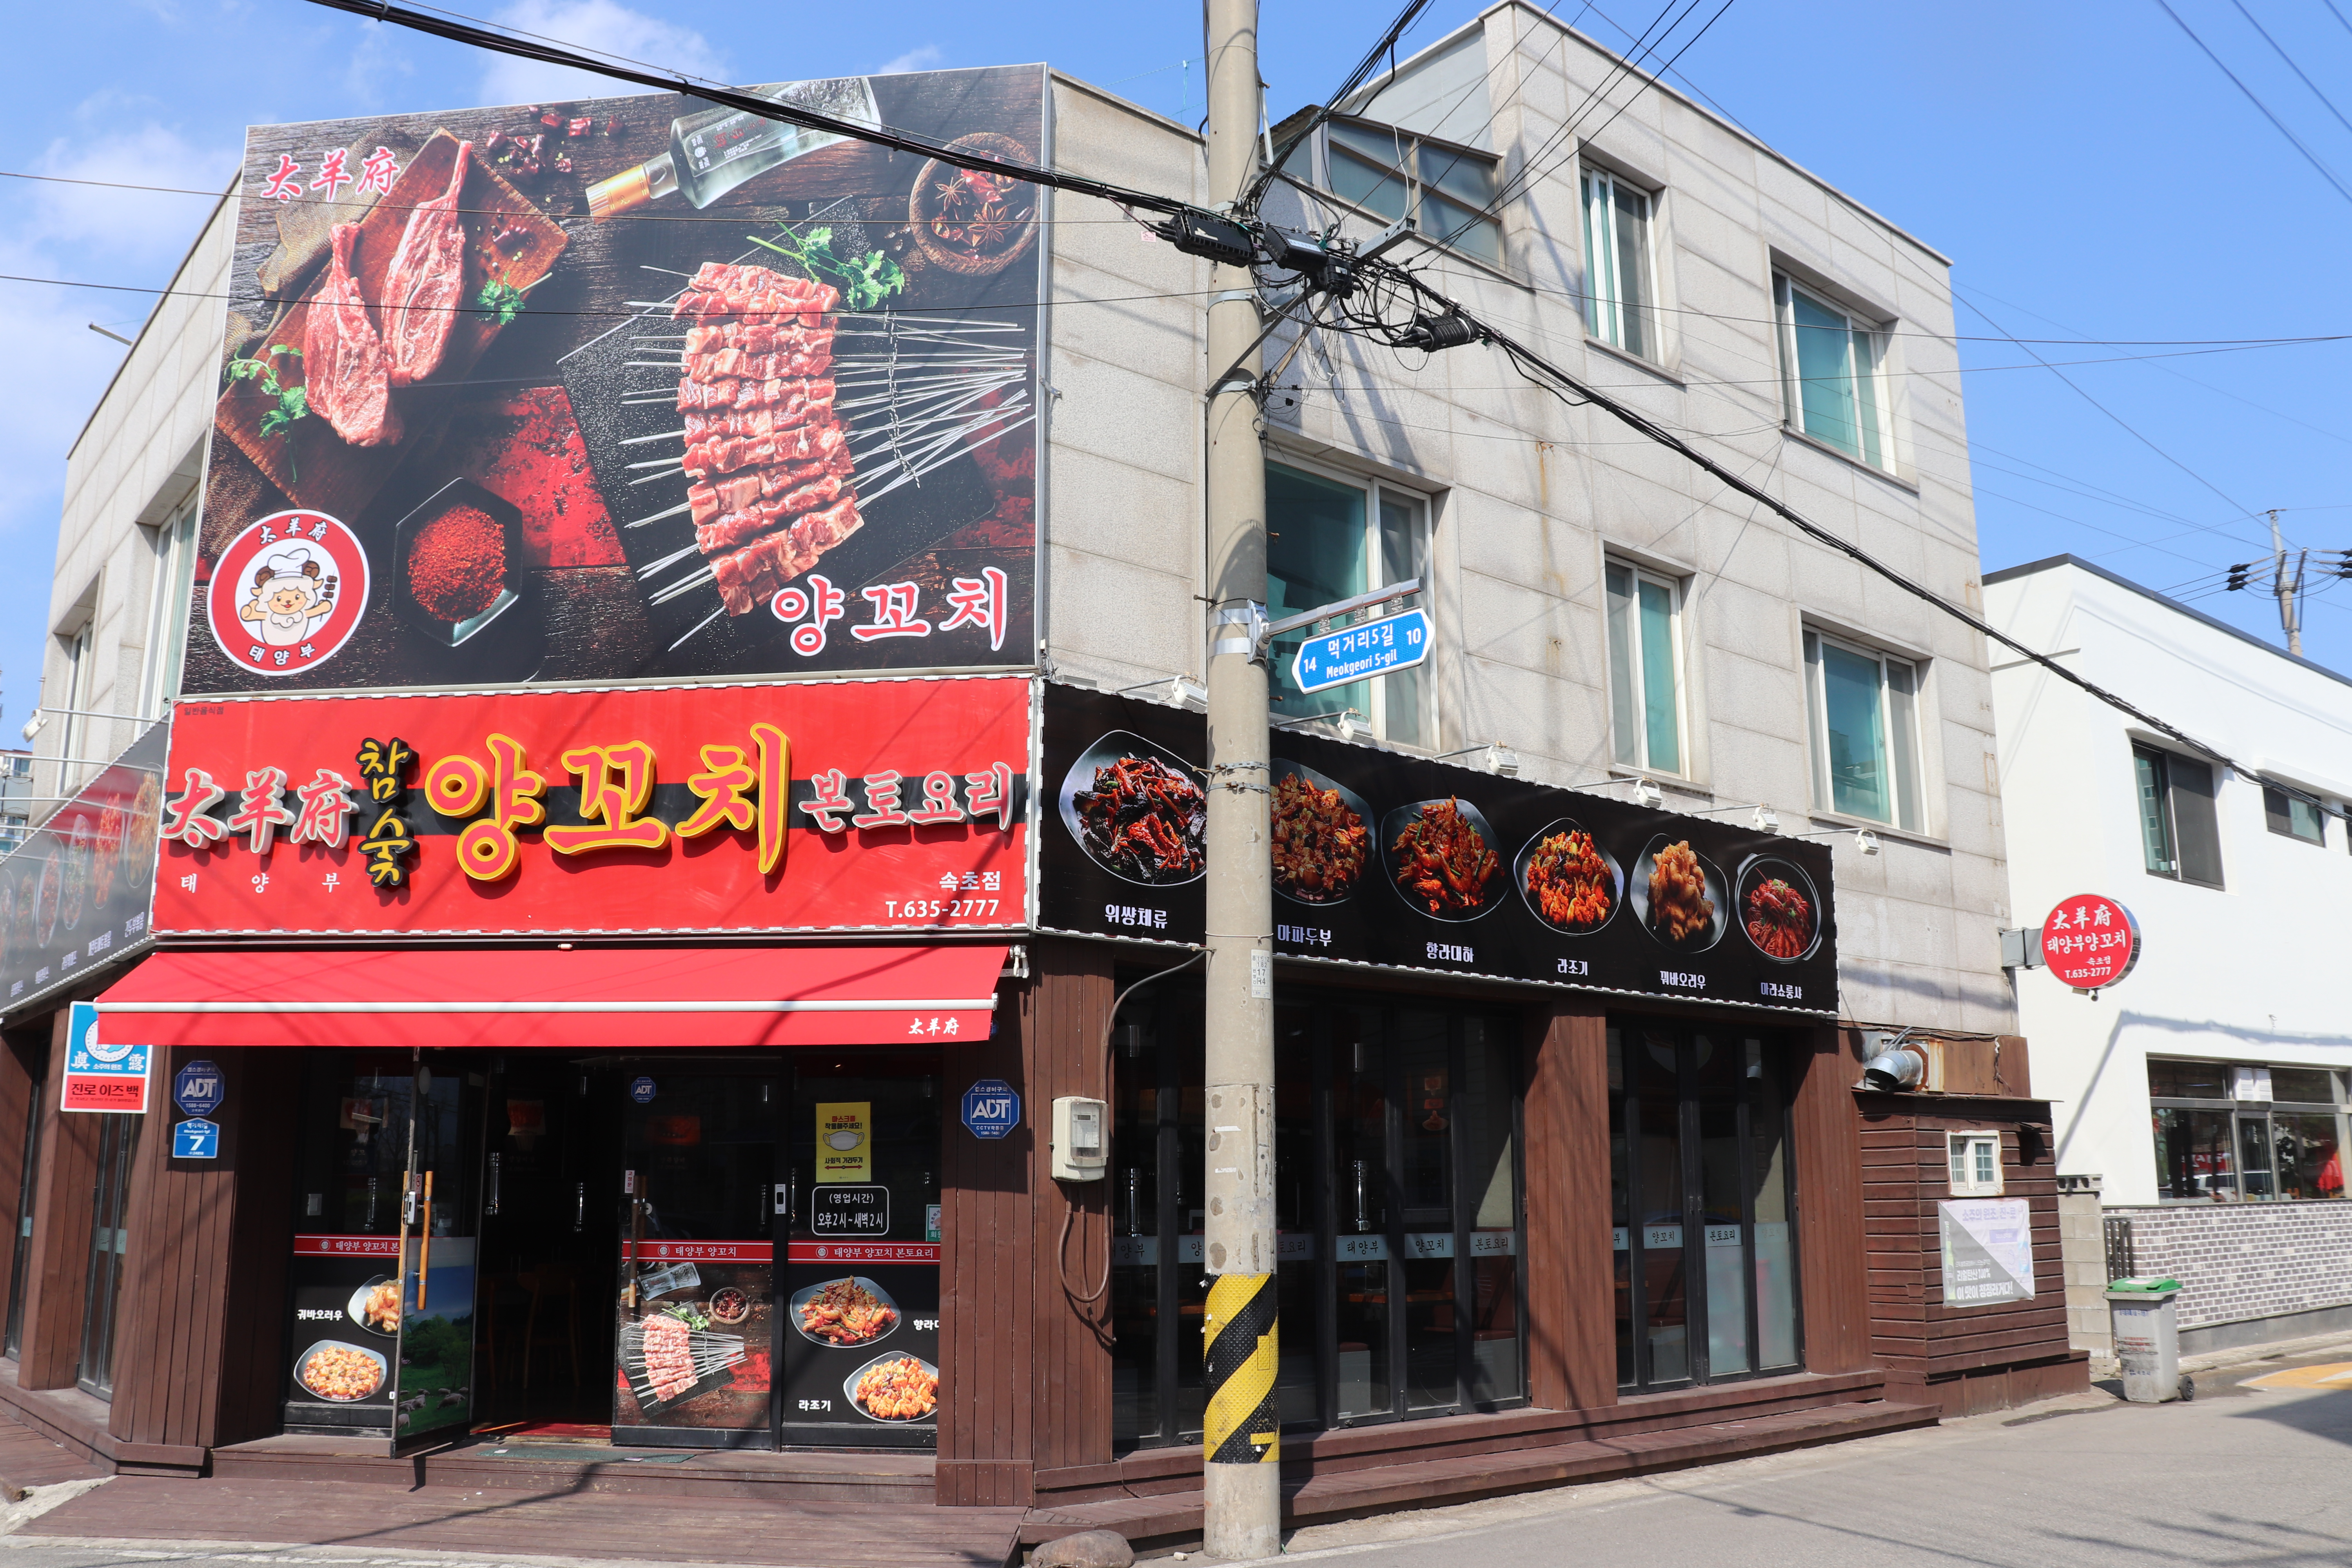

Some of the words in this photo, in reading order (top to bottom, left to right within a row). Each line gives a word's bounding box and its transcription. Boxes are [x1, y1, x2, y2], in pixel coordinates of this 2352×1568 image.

[261, 147, 400, 204] 太羊府
[260, 516, 328, 544] 太羊府
[770, 566, 1007, 656] 양꼬치
[249, 643, 315, 665] 태양부
[1303, 656, 1316, 673] 14
[1328, 623, 1393, 659] 먹거리5길
[1406, 628, 1421, 645] 10
[1326, 655, 1372, 679] Meokgeori
[1375, 649, 1397, 668] 5-gil
[425, 722, 790, 881] 양꼬치
[799, 762, 1014, 833] 본토요리
[160, 766, 359, 855] 太羊府
[356, 737, 418, 887] 참숯
[181, 873, 340, 893] 태양부
[939, 871, 1000, 891] 속초점
[885, 899, 999, 918] T.635-2777
[2053, 904, 2112, 930] 太羊府
[1278, 924, 1332, 946] 마파두부
[1426, 942, 1474, 963] 향라대하
[2086, 956, 2111, 965] 속초점
[1557, 958, 1588, 976] 라조기
[2065, 967, 2111, 978] T.635-2777
[1761, 982, 1802, 999] 마라쇼룽샤
[908, 1018, 959, 1036] 太羊府
[71, 1084, 96, 1095] 진로
[100, 1085, 123, 1096] 이즈
[127, 1085, 139, 1097] 백
[182, 1078, 217, 1097] ADT
[635, 1085, 652, 1094] ADT
[972, 1099, 1010, 1118] ADT
[190, 1136, 204, 1151] 7
[829, 1193, 874, 1203] (영업시간)
[1476, 1236, 1508, 1250] 본토요리
[1652, 1231, 1674, 1243] 양꼬치
[1710, 1229, 1735, 1241] 본토요리
[336, 1241, 360, 1251] 태양부
[363, 1241, 387, 1252] 양꼬치
[390, 1242, 400, 1252] 본
[675, 1246, 704, 1256] 태양부
[708, 1247, 736, 1257] 양꼬치
[834, 1247, 862, 1258] 태양부
[865, 1248, 892, 1258] 양꼬치
[896, 1248, 933, 1258] 본토요리
[1347, 1240, 1378, 1255] 태양부
[1416, 1238, 1444, 1253] 양꼬치
[1957, 1269, 1978, 1281] 리얼탄산
[1978, 1268, 1991, 1279] 100%
[1957, 1287, 1964, 1299] 이
[1965, 1285, 1979, 1299] 맛이
[1979, 1281, 2013, 1298] 청정라거다!
[799, 1399, 831, 1412] 라조기
